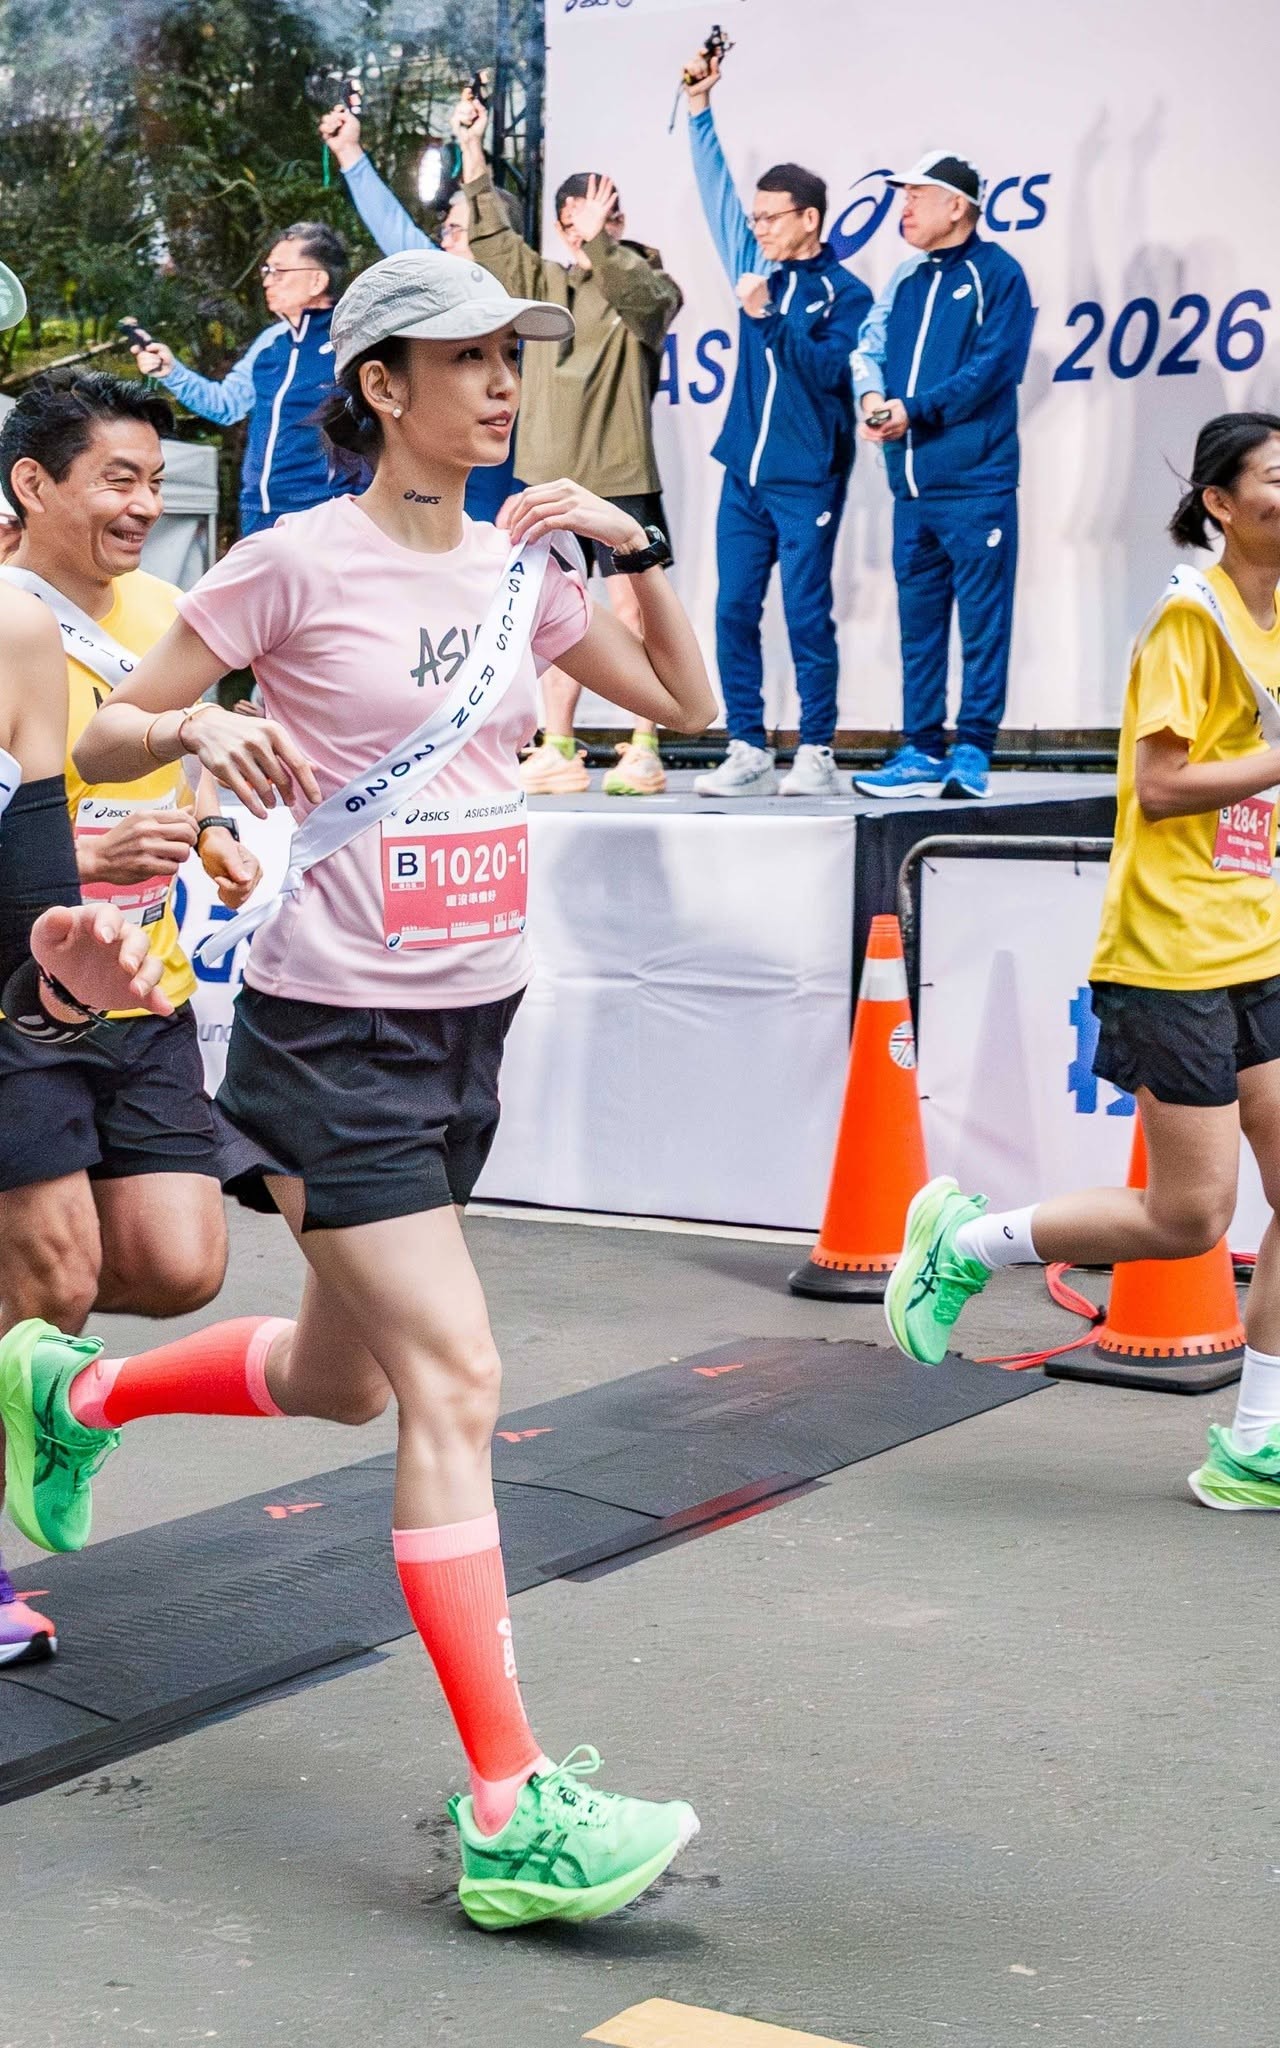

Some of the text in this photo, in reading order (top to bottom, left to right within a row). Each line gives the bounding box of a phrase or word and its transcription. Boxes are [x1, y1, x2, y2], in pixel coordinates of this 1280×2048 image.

[1052, 289, 1272, 383] 2026
[60, 622, 135, 673] ASIC
[345, 561, 526, 813] ASICS RUN 2026
[397, 838, 527, 887] B 1020-1
